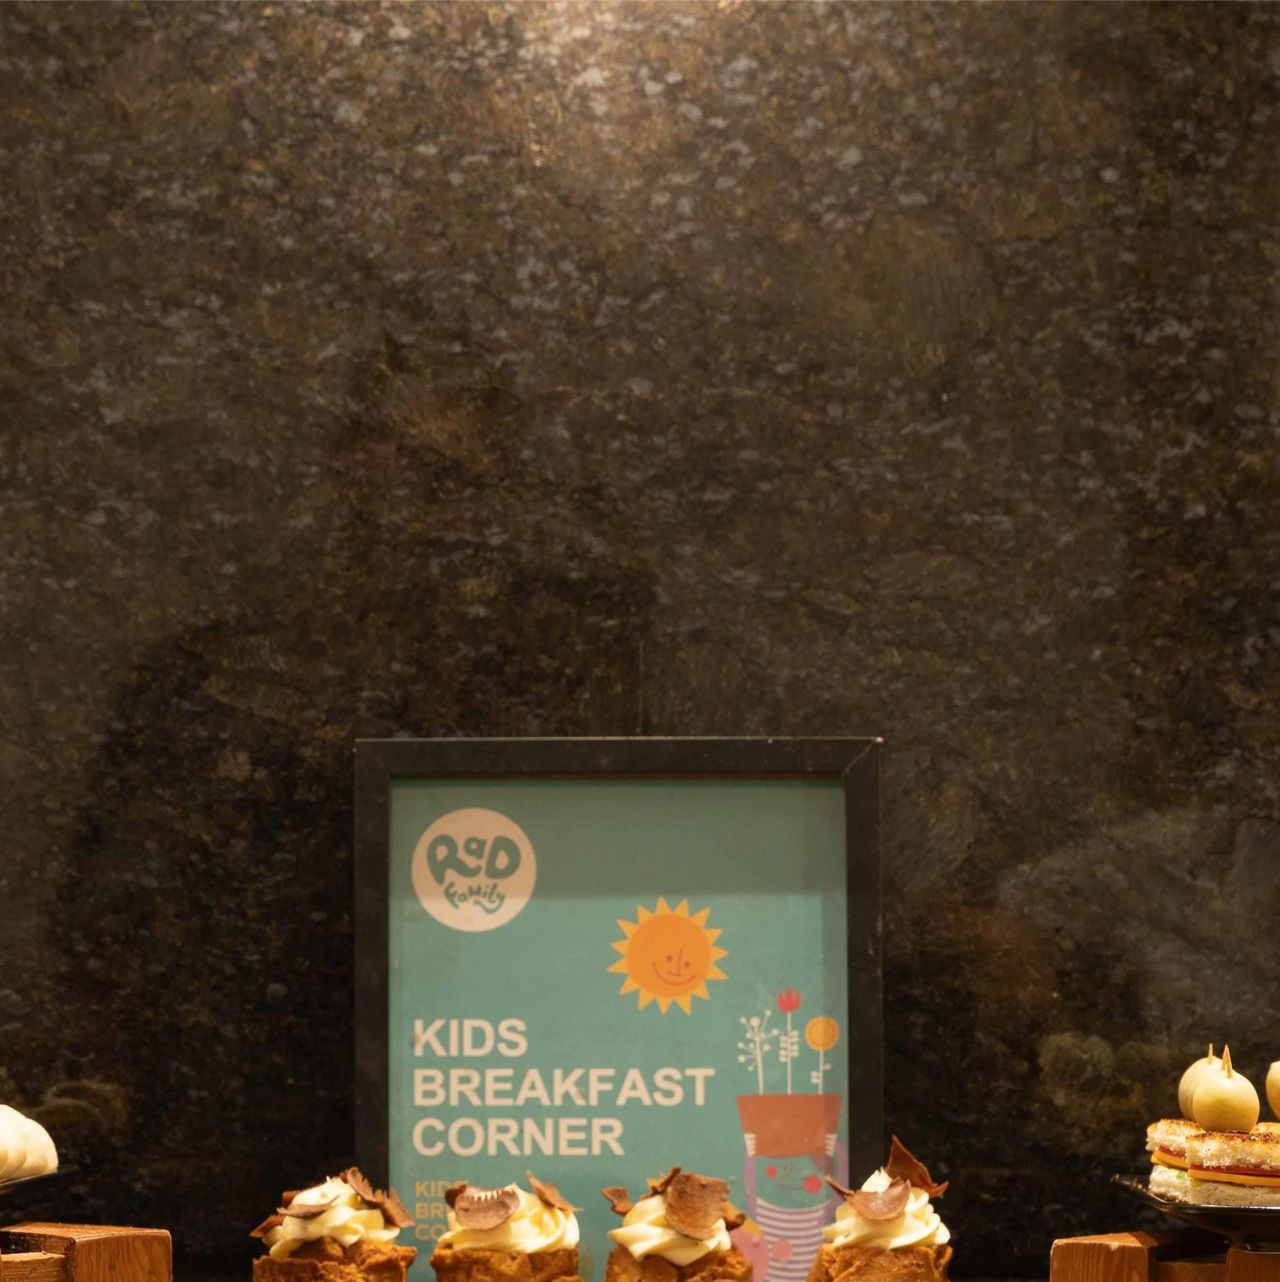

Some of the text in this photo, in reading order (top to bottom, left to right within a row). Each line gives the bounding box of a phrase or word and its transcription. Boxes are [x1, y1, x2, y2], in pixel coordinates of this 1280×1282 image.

[413, 1019, 528, 1057] KIDS
[413, 1068, 715, 1106] BREAKFAST
[412, 1117, 625, 1156] CORNER
